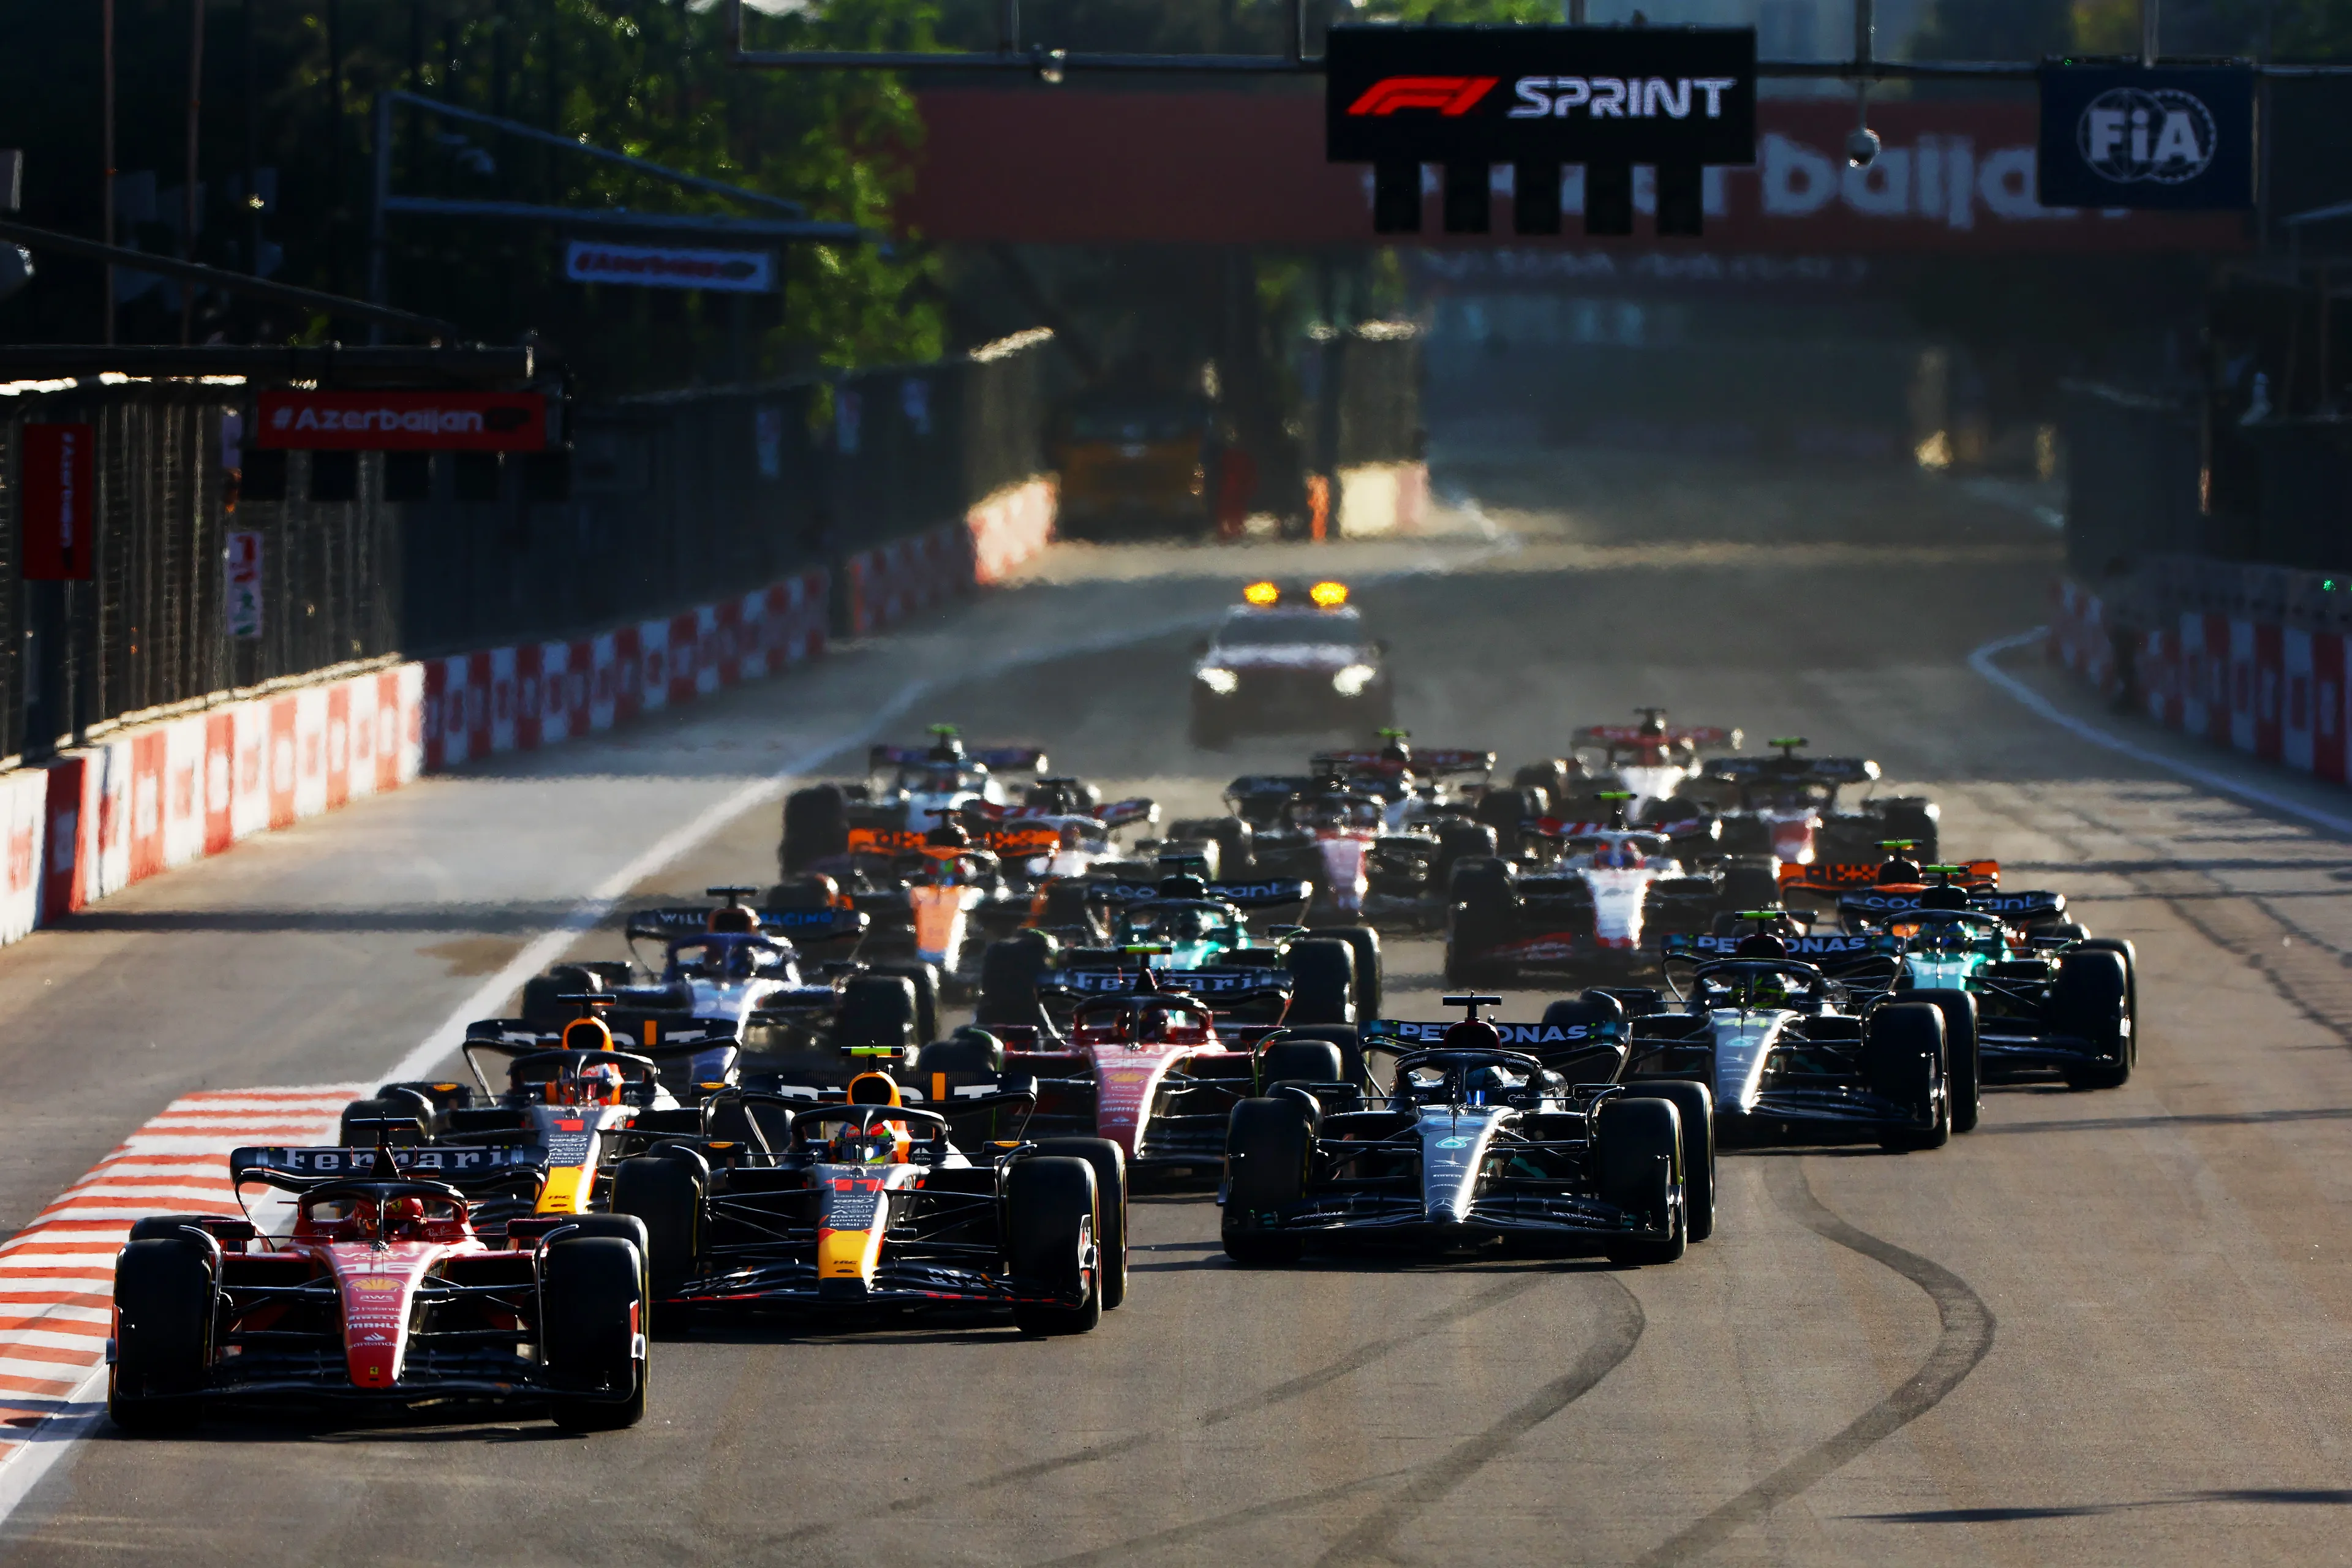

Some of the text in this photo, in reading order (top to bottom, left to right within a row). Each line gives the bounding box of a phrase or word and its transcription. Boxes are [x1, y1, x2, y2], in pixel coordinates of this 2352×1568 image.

[1507, 77, 1737, 118] SPRINT
[272, 405, 484, 434] #Azerbaijan
[1697, 935, 1866, 954] PEONAS
[1400, 1023, 1588, 1043] PEONAS
